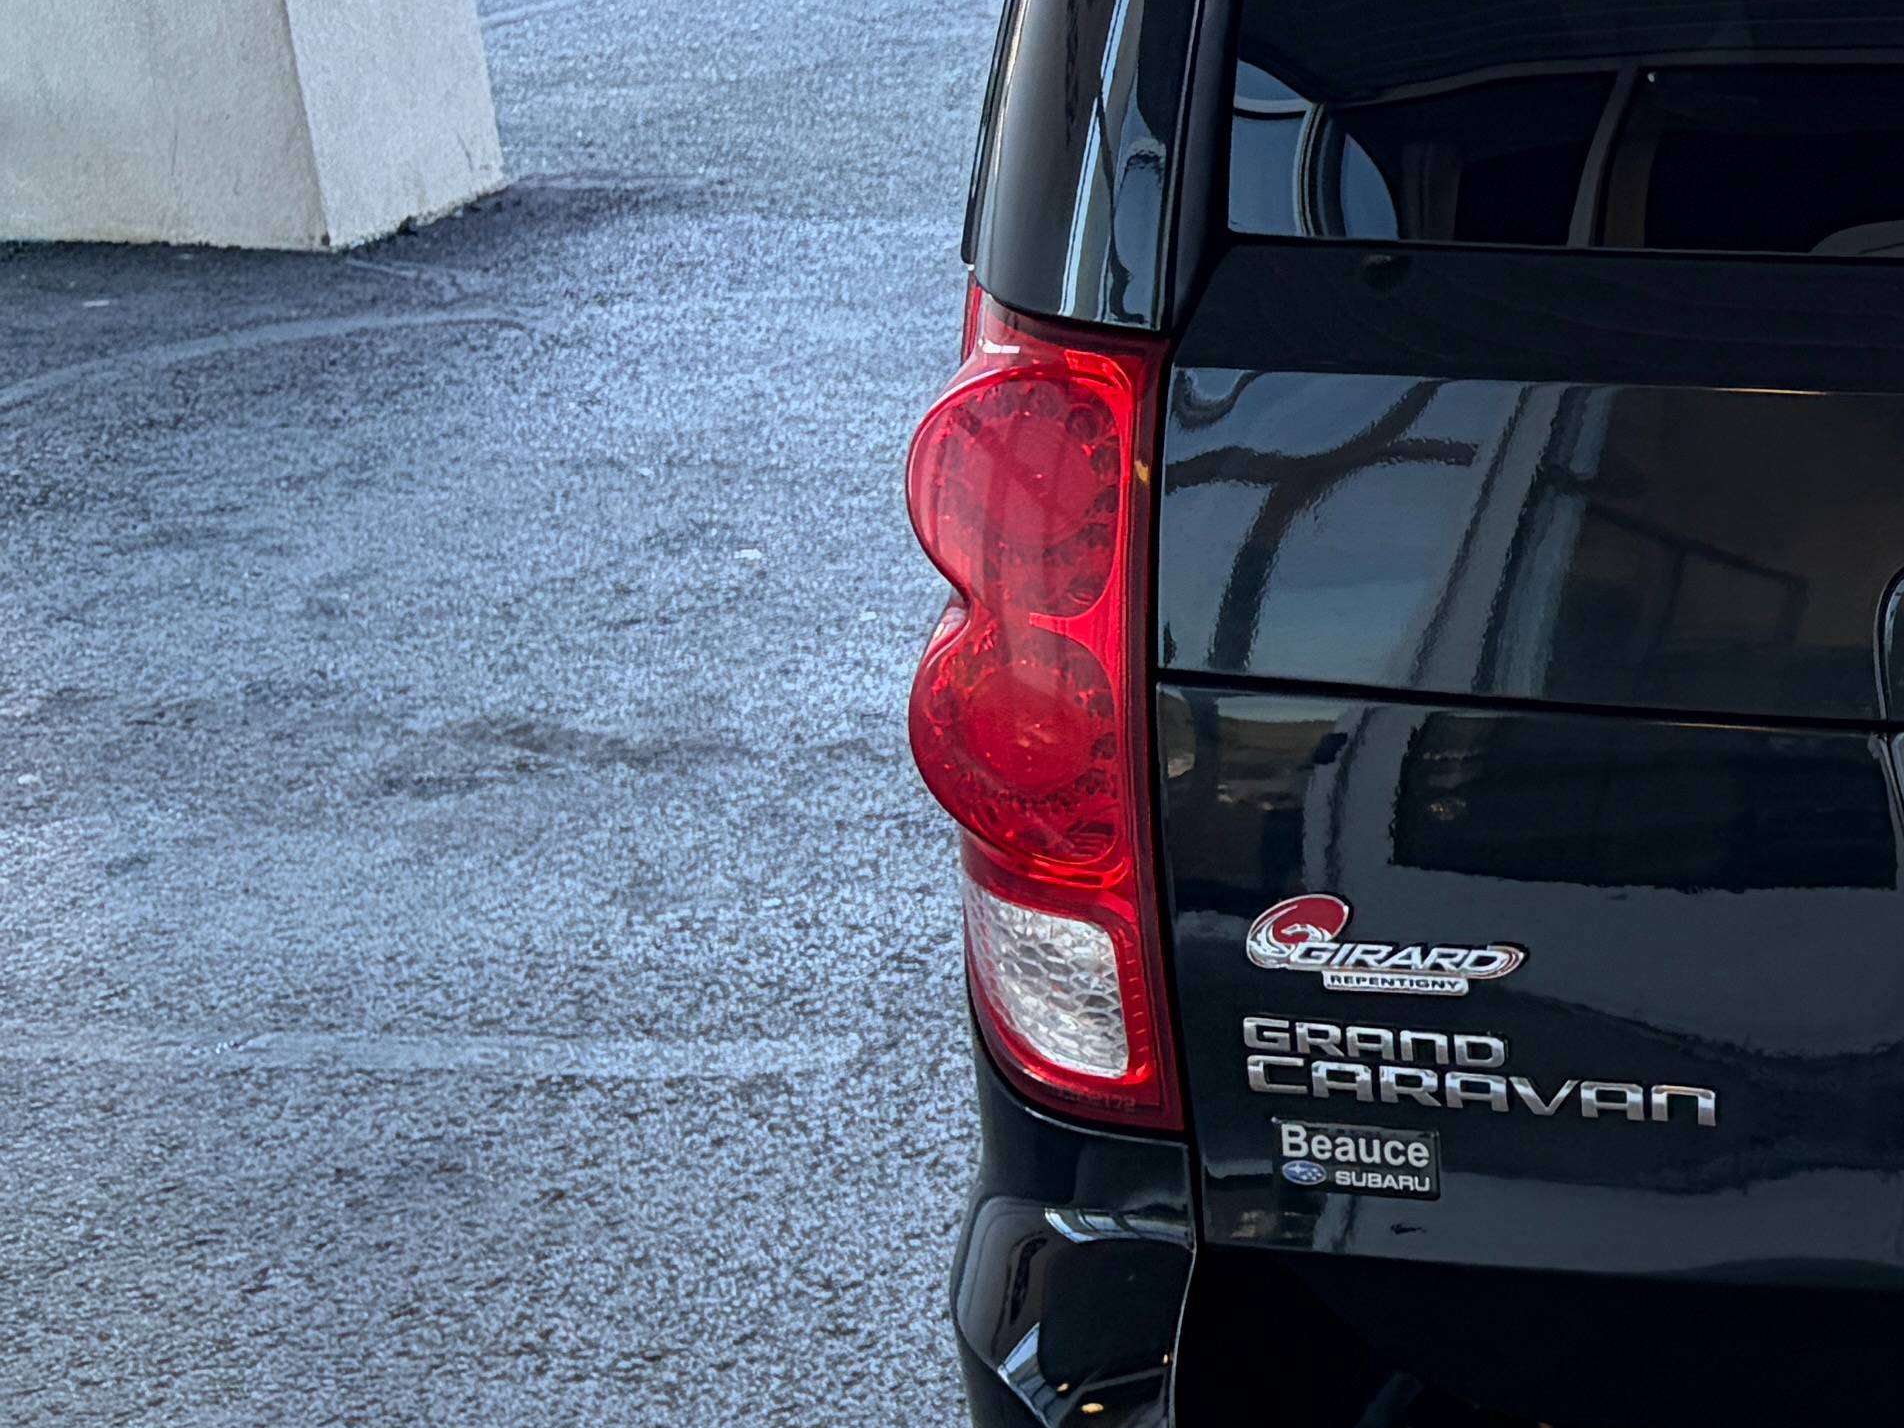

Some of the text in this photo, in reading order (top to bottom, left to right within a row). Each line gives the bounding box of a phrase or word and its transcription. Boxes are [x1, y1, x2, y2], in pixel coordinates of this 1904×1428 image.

[1289, 942, 1507, 971] GIRARD
[1329, 974, 1460, 990] REPENTIGNY
[1243, 1017, 1507, 1067] GRAND
[1247, 1055, 1717, 1127] CARAVAN
[1281, 1123, 1430, 1168] Beauce
[1335, 1171, 1431, 1193] SUBARU
